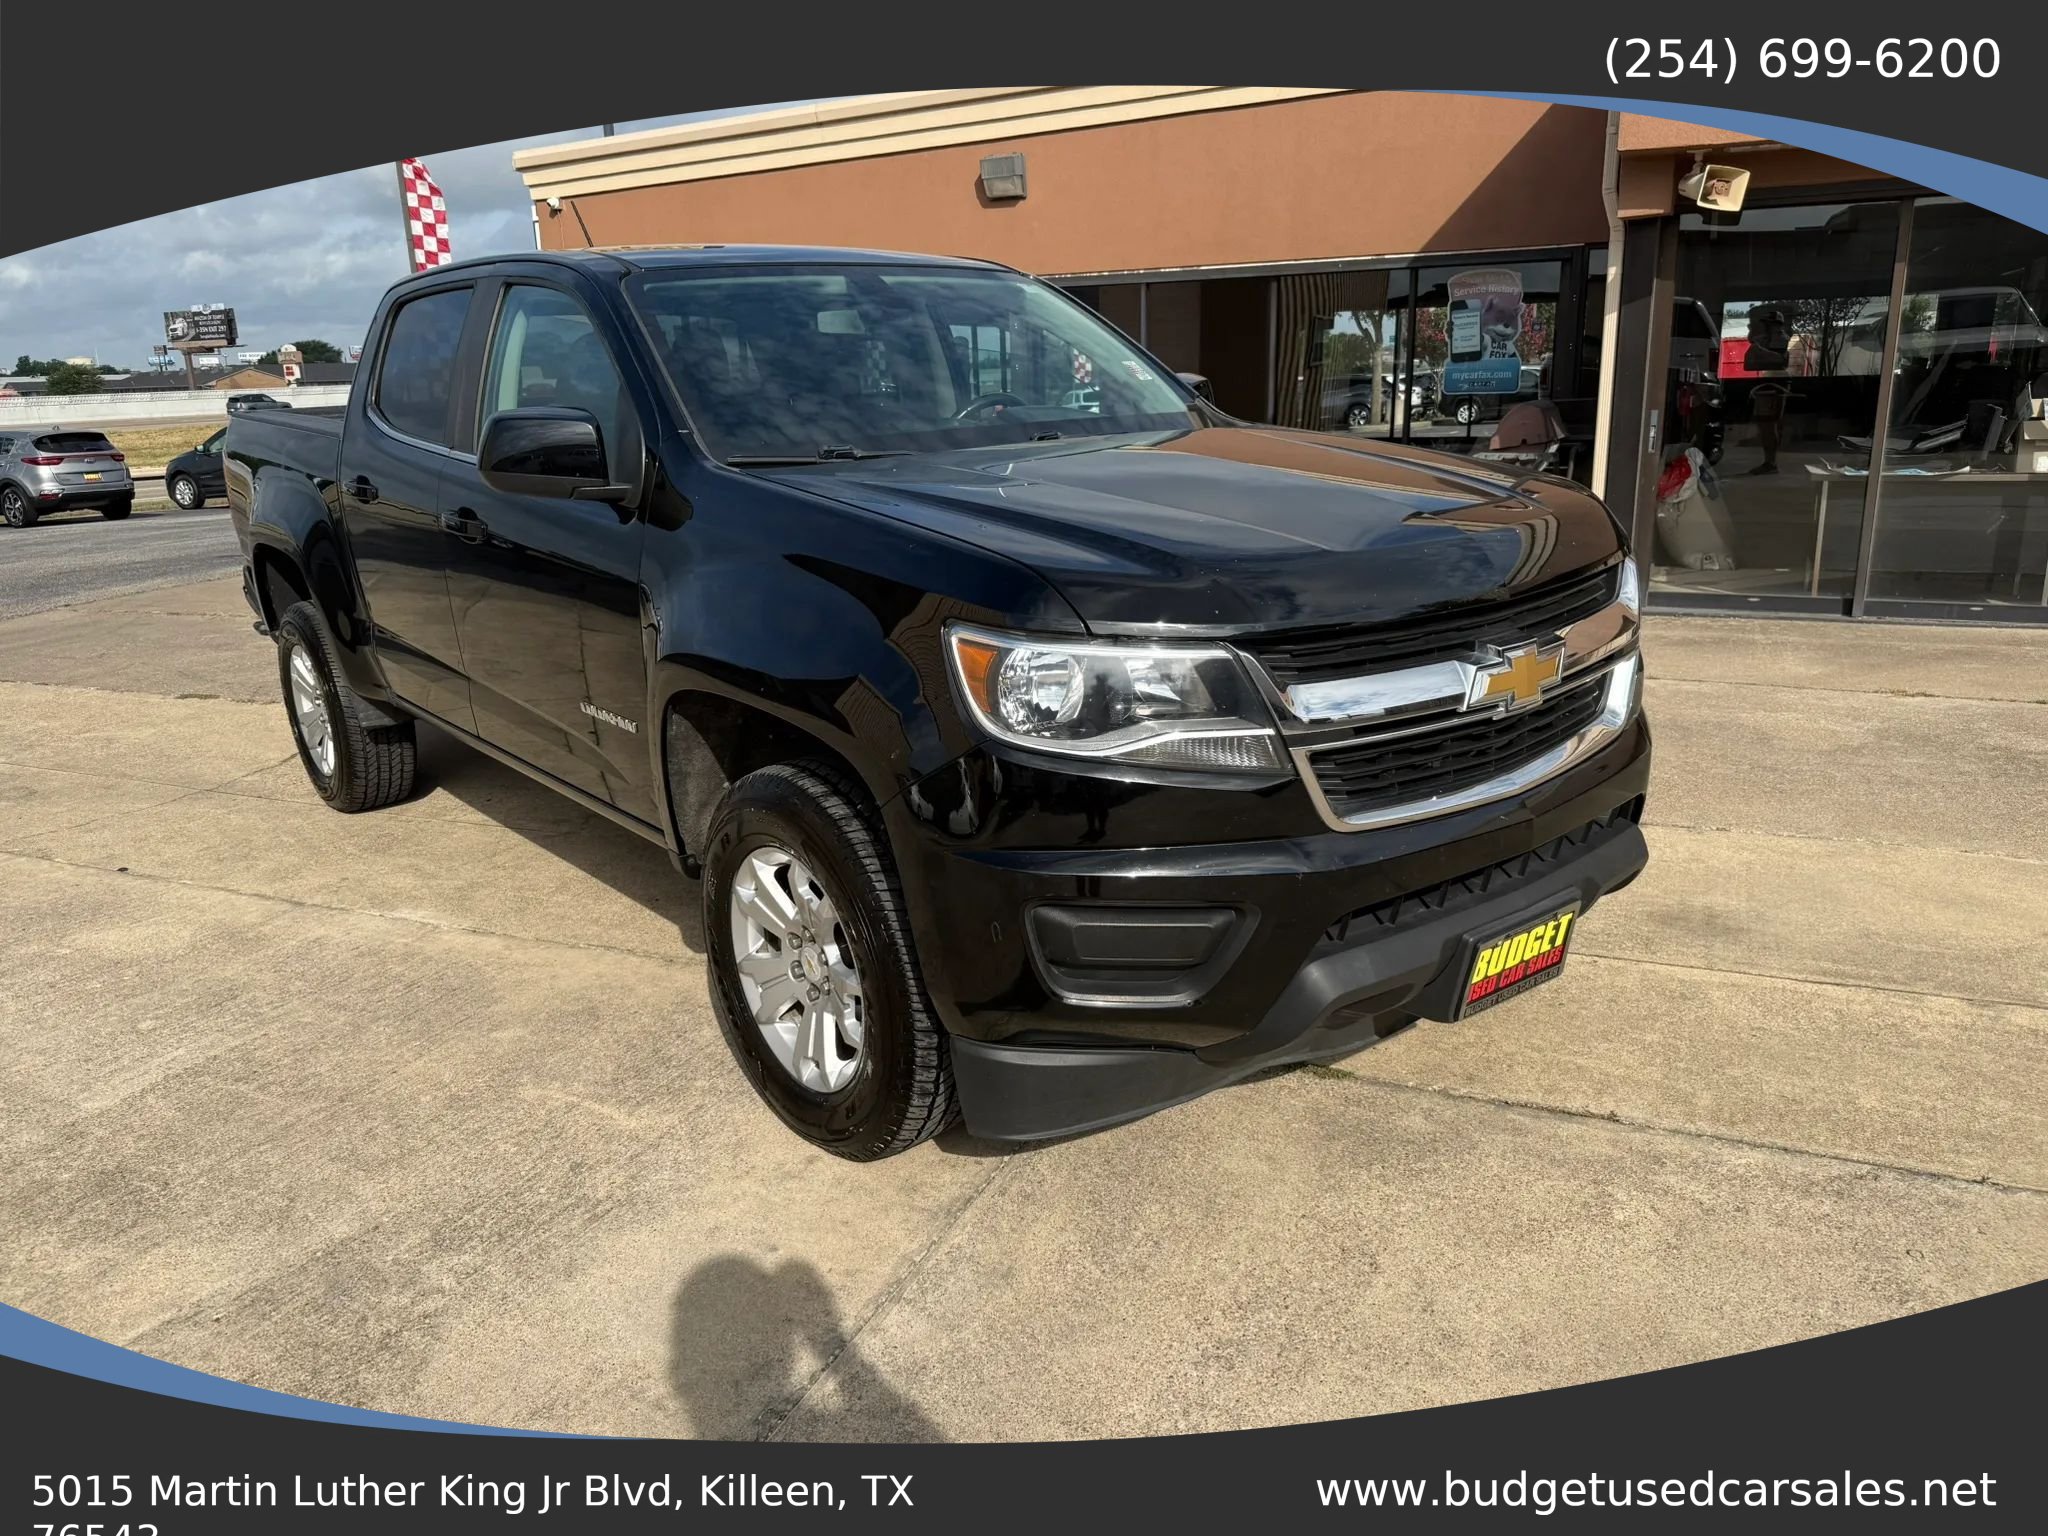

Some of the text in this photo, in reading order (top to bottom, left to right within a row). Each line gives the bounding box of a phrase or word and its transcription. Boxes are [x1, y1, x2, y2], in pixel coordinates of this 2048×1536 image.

[1454, 284, 1519, 297] Service History
[1491, 341, 1507, 351] CAR
[1489, 350, 1507, 359] FOX
[1452, 370, 1512, 381] mycarfax.com
[1471, 912, 1574, 985] BUDGET
[1500, 962, 1526, 989] CAR
[1527, 945, 1564, 976] SALES
[1465, 998, 1499, 1017] BUDGET
